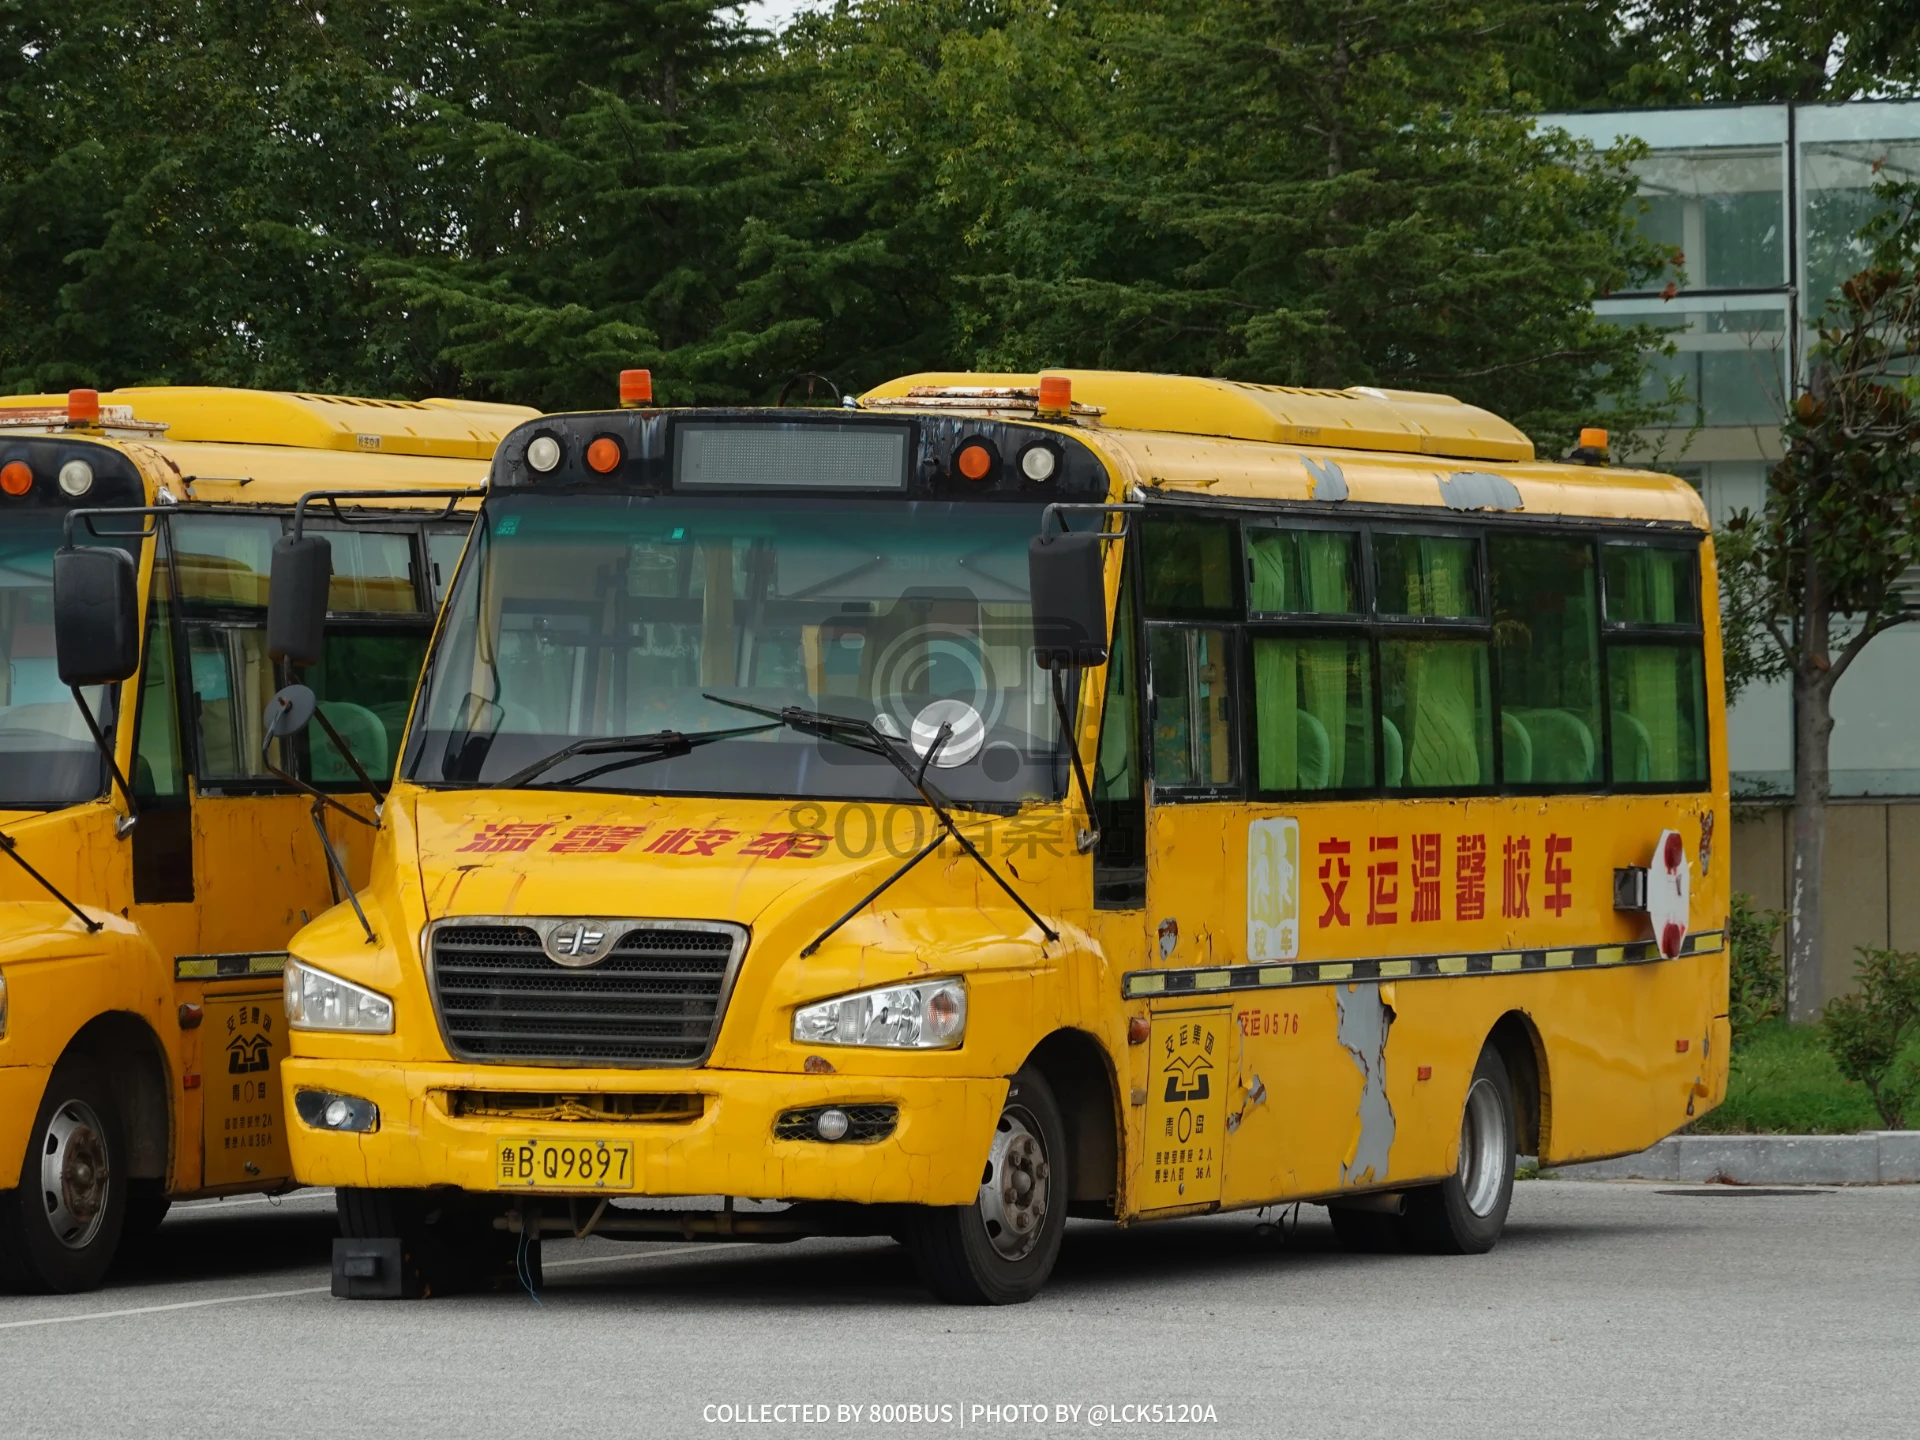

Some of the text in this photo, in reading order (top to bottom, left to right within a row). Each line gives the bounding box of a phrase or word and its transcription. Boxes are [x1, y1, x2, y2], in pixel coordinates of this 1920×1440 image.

[455, 823, 834, 860] 温馨校车
[1318, 833, 1573, 929] 交运温馨校车
[1254, 926, 1293, 957] 校车
[226, 1006, 272, 1036] 交运集团
[1238, 1010, 1299, 1037] 交运0576
[1165, 1023, 1215, 1059] 交运集团
